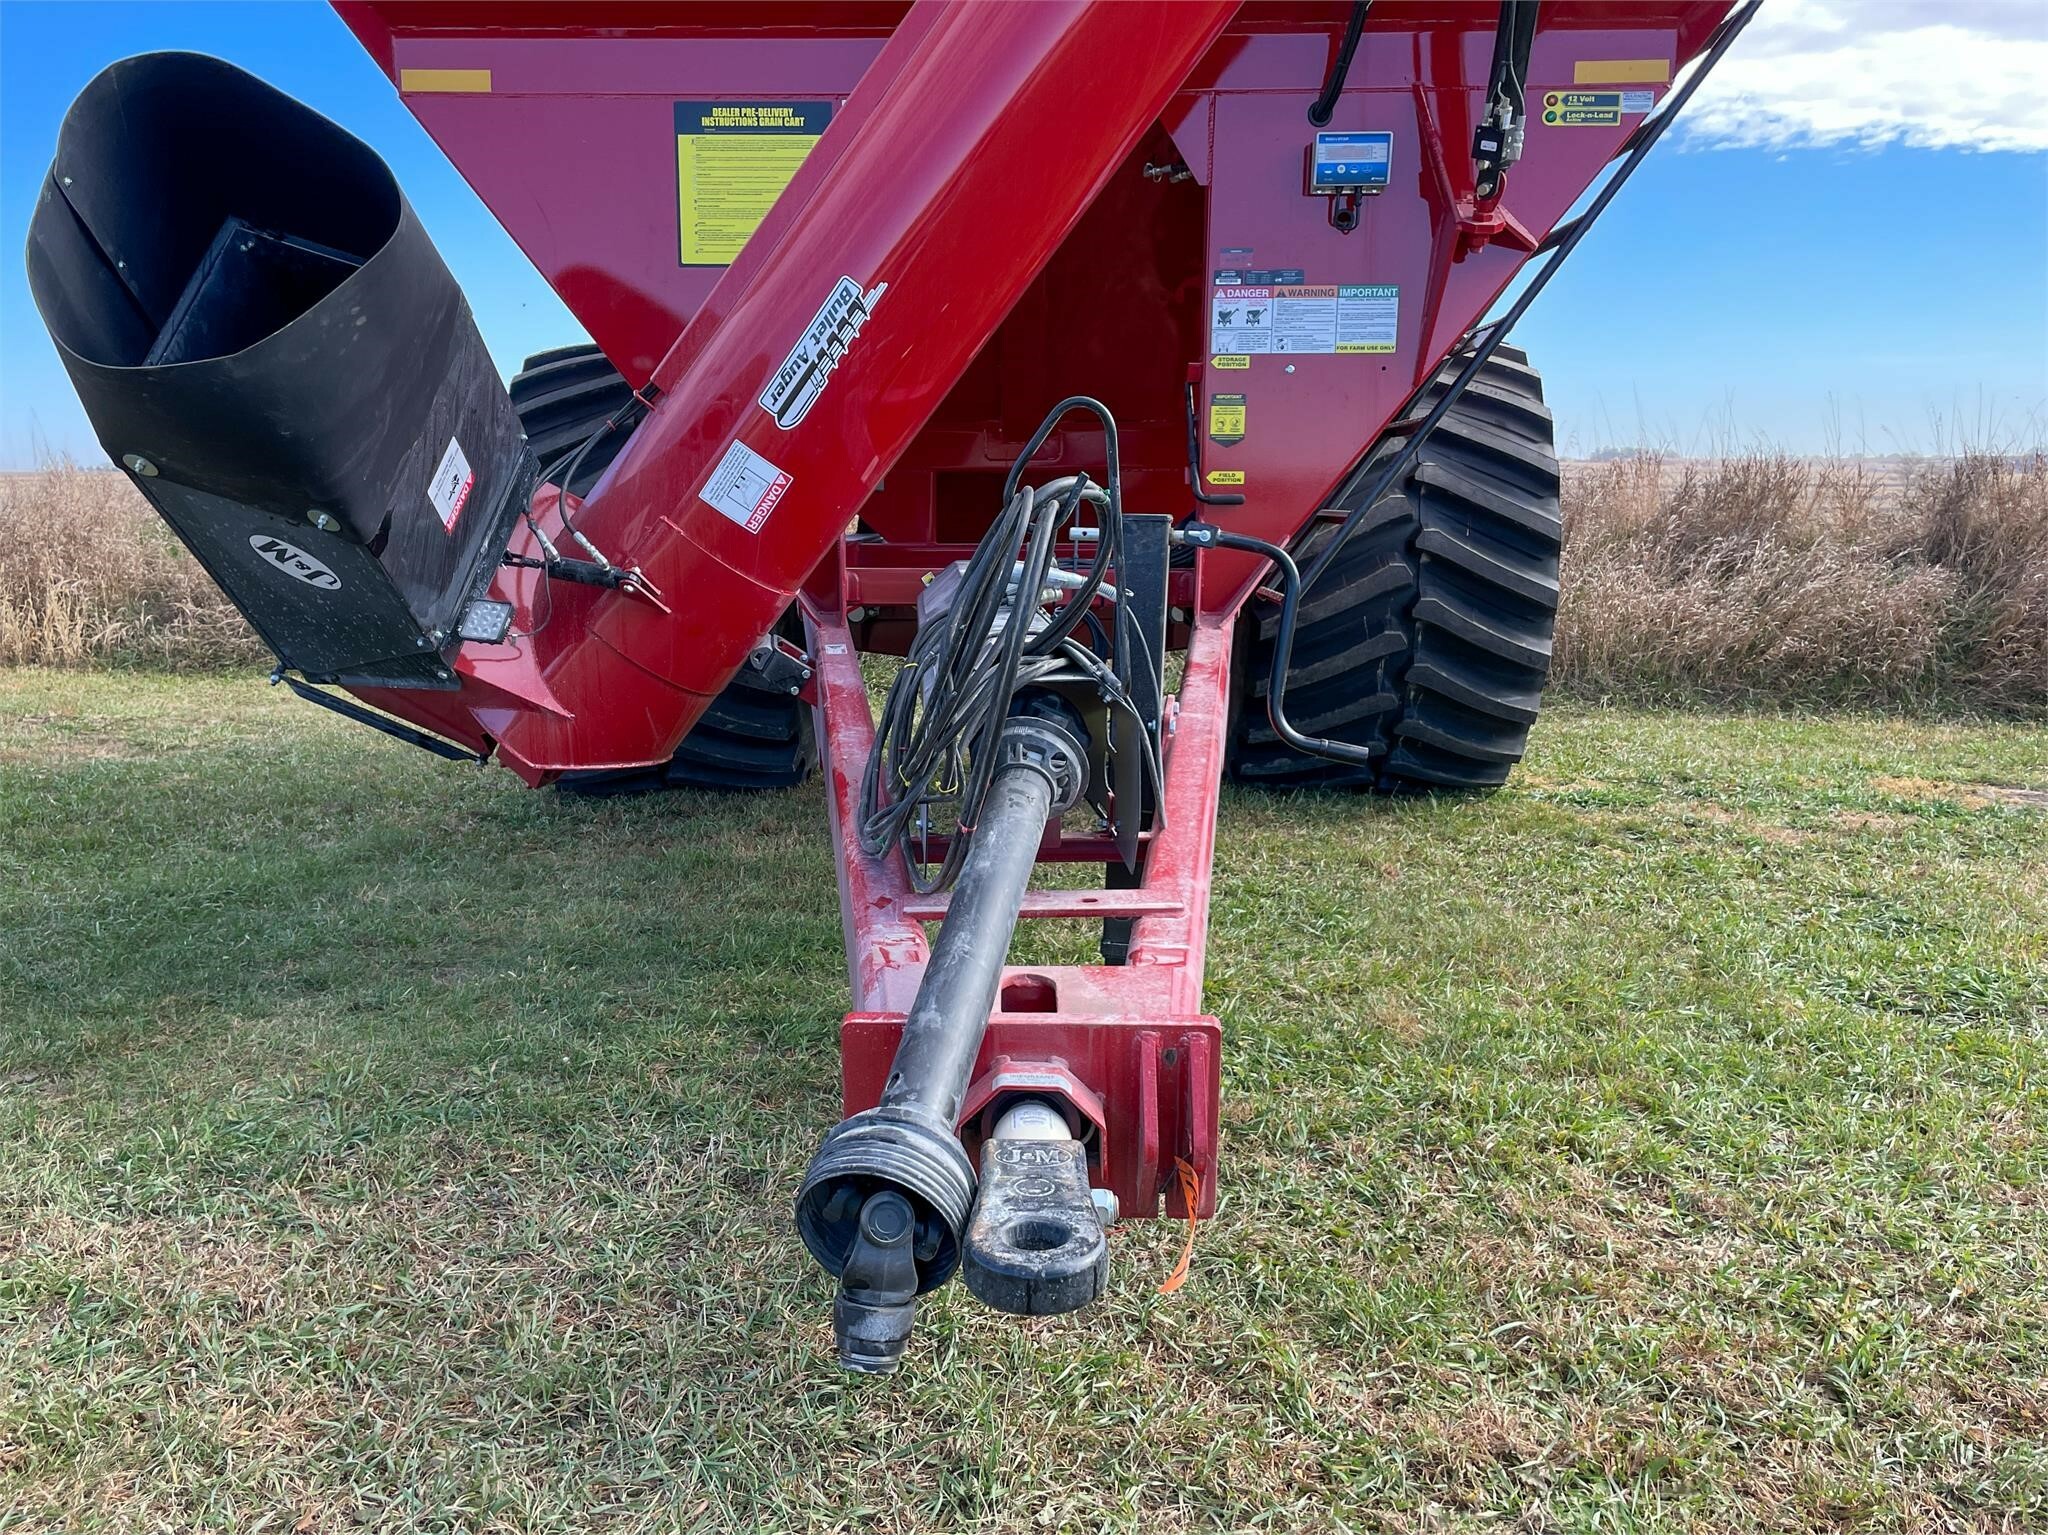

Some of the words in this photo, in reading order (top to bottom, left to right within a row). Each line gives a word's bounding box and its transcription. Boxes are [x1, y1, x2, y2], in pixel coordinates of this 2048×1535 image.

[712, 107, 741, 117] DEALER
[741, 107, 794, 117] PRE-DELIVERY
[701, 117, 758, 127] INSTRUCTIONS
[759, 117, 784, 127] GRAIN
[784, 117, 805, 127] CART
[1227, 289, 1269, 298] DANGER
[1288, 288, 1335, 297] WARNING
[1339, 288, 1398, 297] IMPORTANT
[814, 285, 854, 345] Bullet
[771, 345, 810, 406] Auger
[747, 484, 782, 530] DANGER
[253, 539, 339, 587] J&M
[1002, 1149, 1060, 1163] J&M
